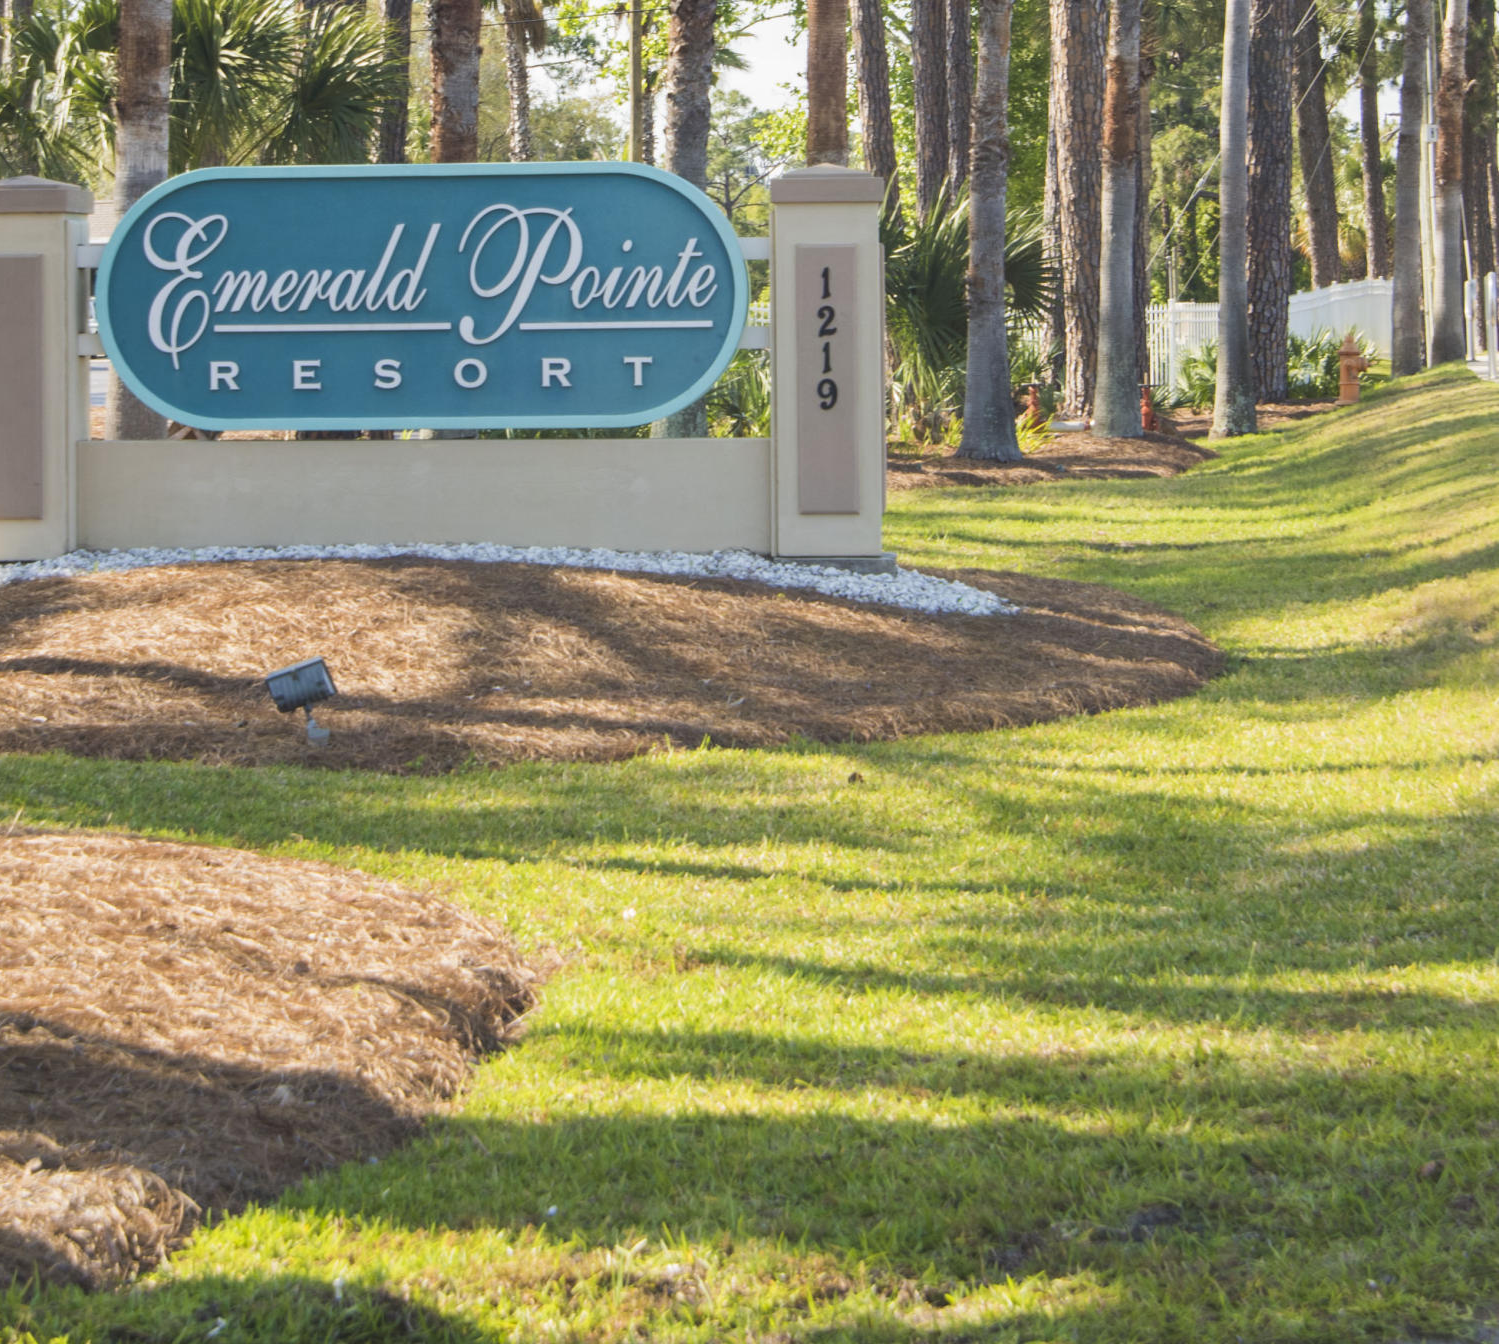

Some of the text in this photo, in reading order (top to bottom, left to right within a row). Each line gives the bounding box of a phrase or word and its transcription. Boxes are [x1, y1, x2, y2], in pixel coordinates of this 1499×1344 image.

[142, 203, 717, 369] Emerald Pointe
[817, 266, 839, 411] 1219
[209, 356, 654, 391] RESORT
